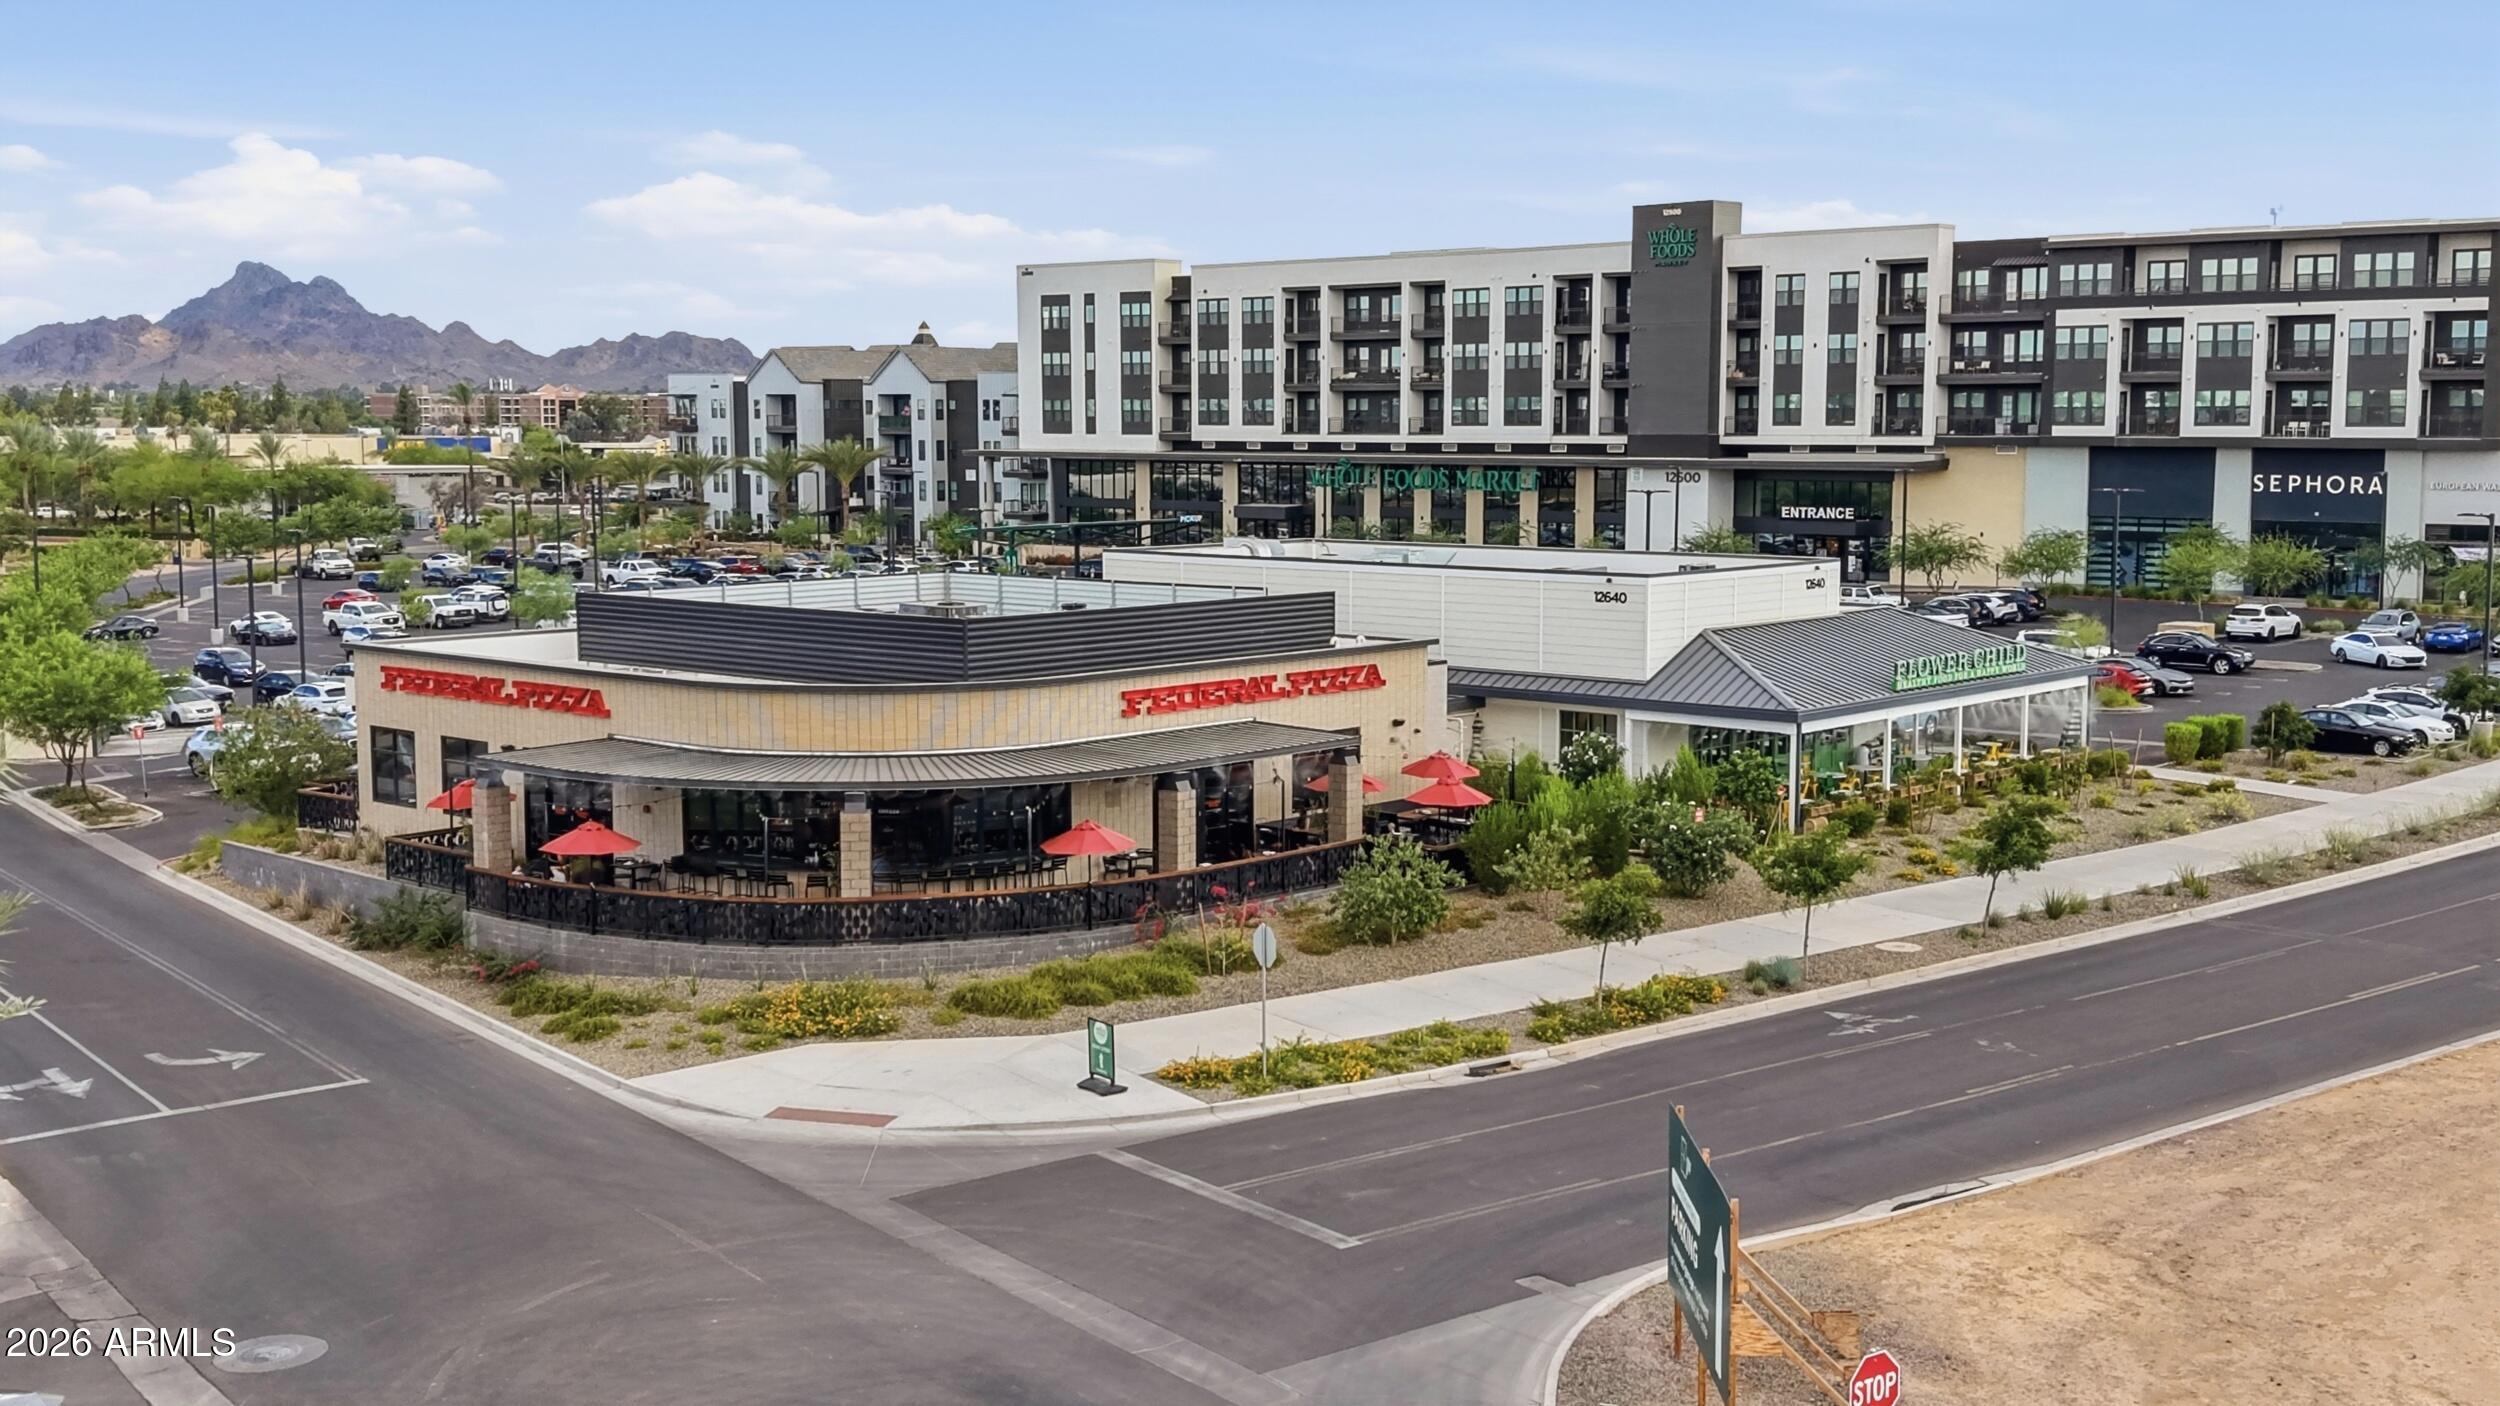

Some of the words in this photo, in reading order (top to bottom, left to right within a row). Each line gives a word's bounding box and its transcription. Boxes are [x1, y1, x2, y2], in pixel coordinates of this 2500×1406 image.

[1647, 227, 1697, 243] WHOLE
[1649, 243, 1696, 258] FOODS
[1311, 463, 1379, 489] WHOLE
[1383, 467, 1451, 490] FOODS
[1456, 469, 1541, 491] MARKET
[2252, 474, 2384, 495] SEPHORA
[2430, 481, 2480, 491] EUROPEAN
[1781, 506, 1855, 519] ENTRANCE
[1806, 578, 1825, 590] 12640
[1594, 591, 1628, 604] 12640
[1895, 652, 1970, 678] FLOWER
[1974, 644, 2027, 669] CHILD
[380, 665, 514, 706] FEDERAL
[512, 680, 611, 719] PIZZA
[1121, 675, 1286, 718] FEDERAL
[1286, 663, 1387, 698] PIZZA
[1671, 1195, 1699, 1270] PARKING
[1853, 1371, 1897, 1406] STOP
